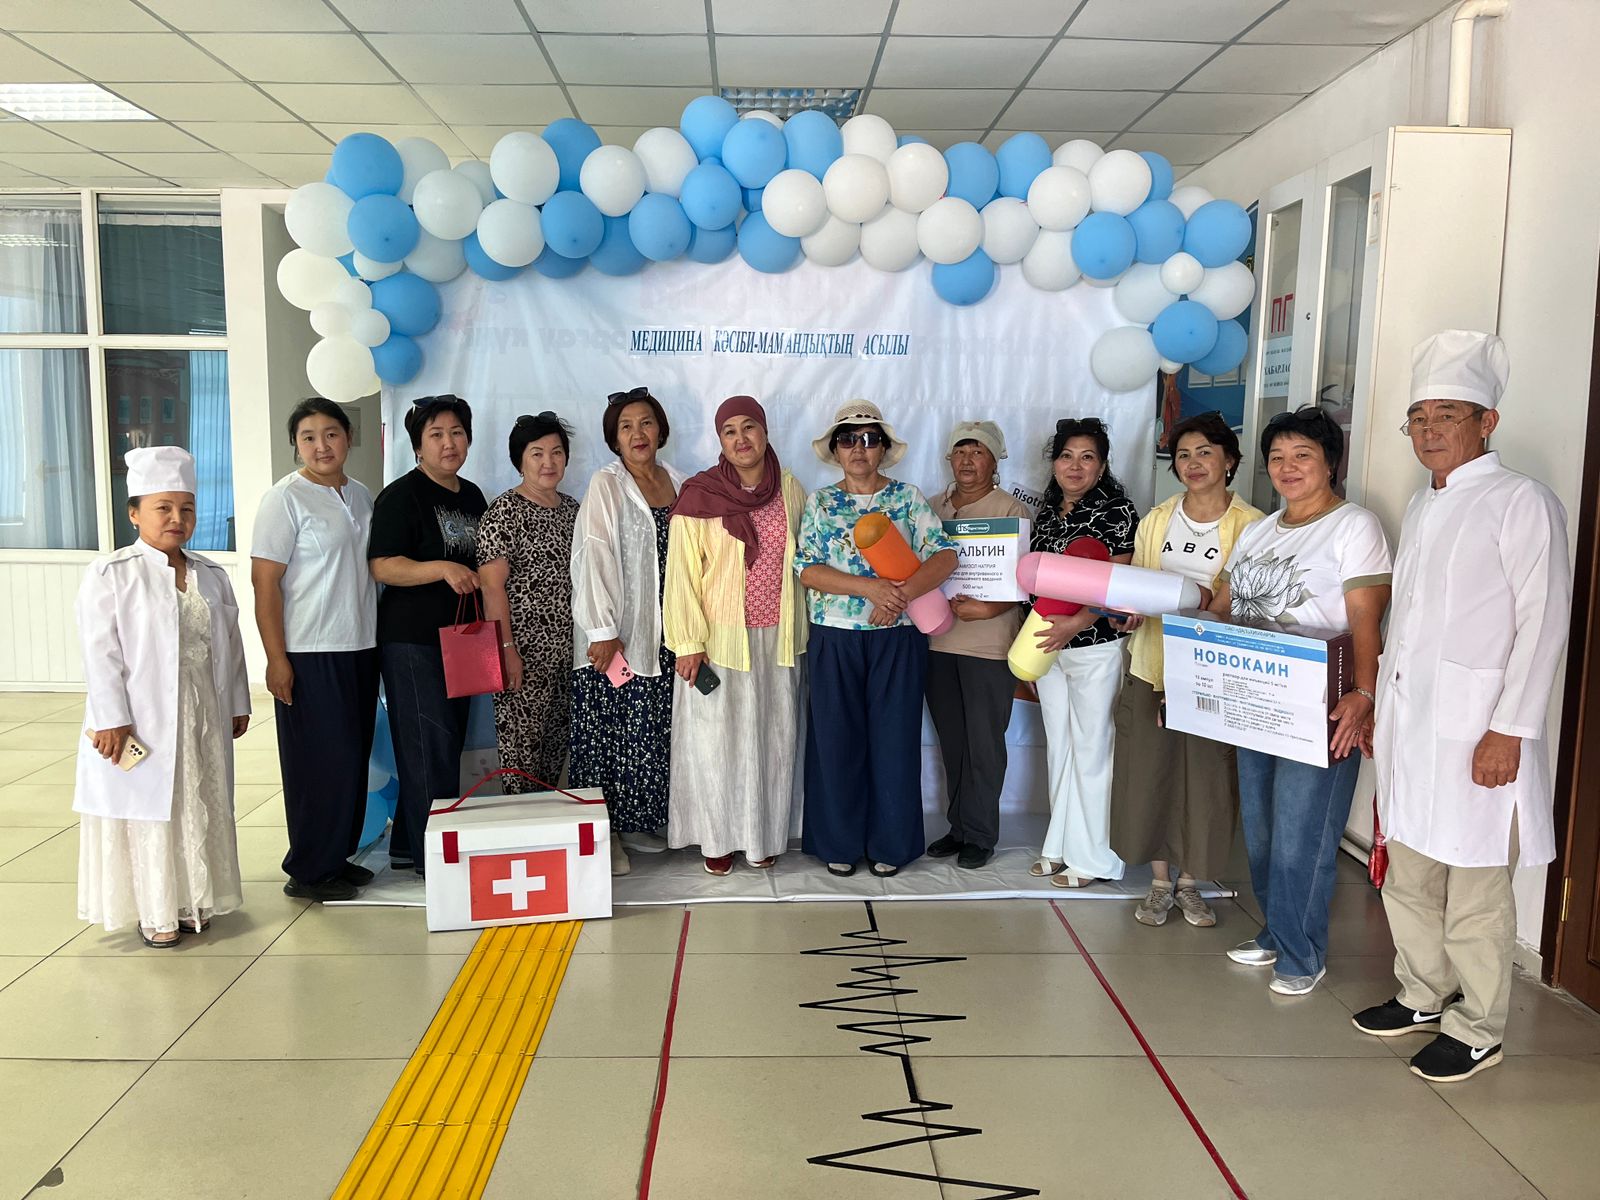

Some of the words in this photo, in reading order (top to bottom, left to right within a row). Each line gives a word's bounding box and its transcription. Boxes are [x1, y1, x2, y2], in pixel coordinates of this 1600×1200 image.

[630, 330, 703, 355] МЕДИЦИНА
[861, 334, 910, 356] АСЫЛЫ
[958, 545, 1006, 558] АЛЬГИН
[1193, 647, 1289, 678] НОВОКАИН
